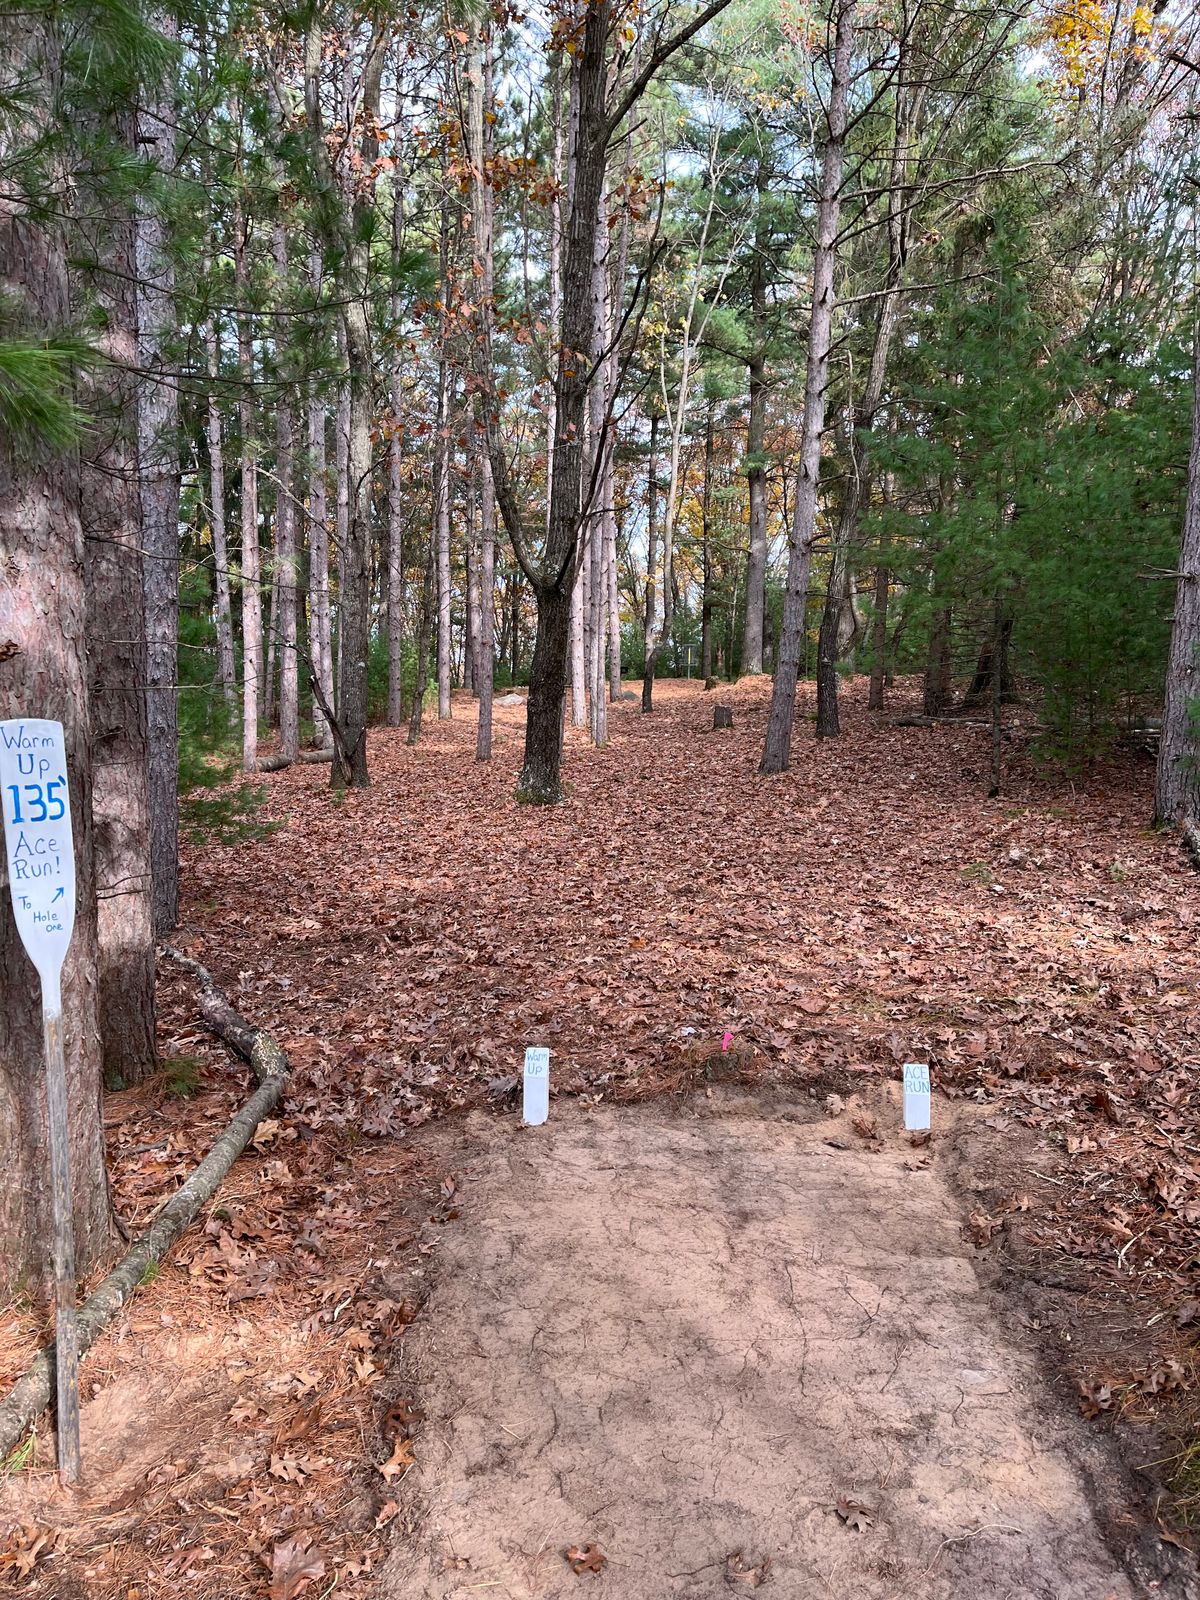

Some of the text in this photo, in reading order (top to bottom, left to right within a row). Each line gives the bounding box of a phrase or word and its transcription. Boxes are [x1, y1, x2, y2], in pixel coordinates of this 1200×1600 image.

[0, 726, 55, 749] Warm
[16, 753, 50, 779] Up
[13, 831, 59, 857] Ace
[12, 856, 60, 879] Run!
[18, 896, 32, 910] To
[33, 911, 58, 923] Hole
[527, 1049, 548, 1061] Warm
[528, 1062, 543, 1075] Up
[904, 1066, 928, 1079] ACE
[905, 1080, 929, 1093] RUN
